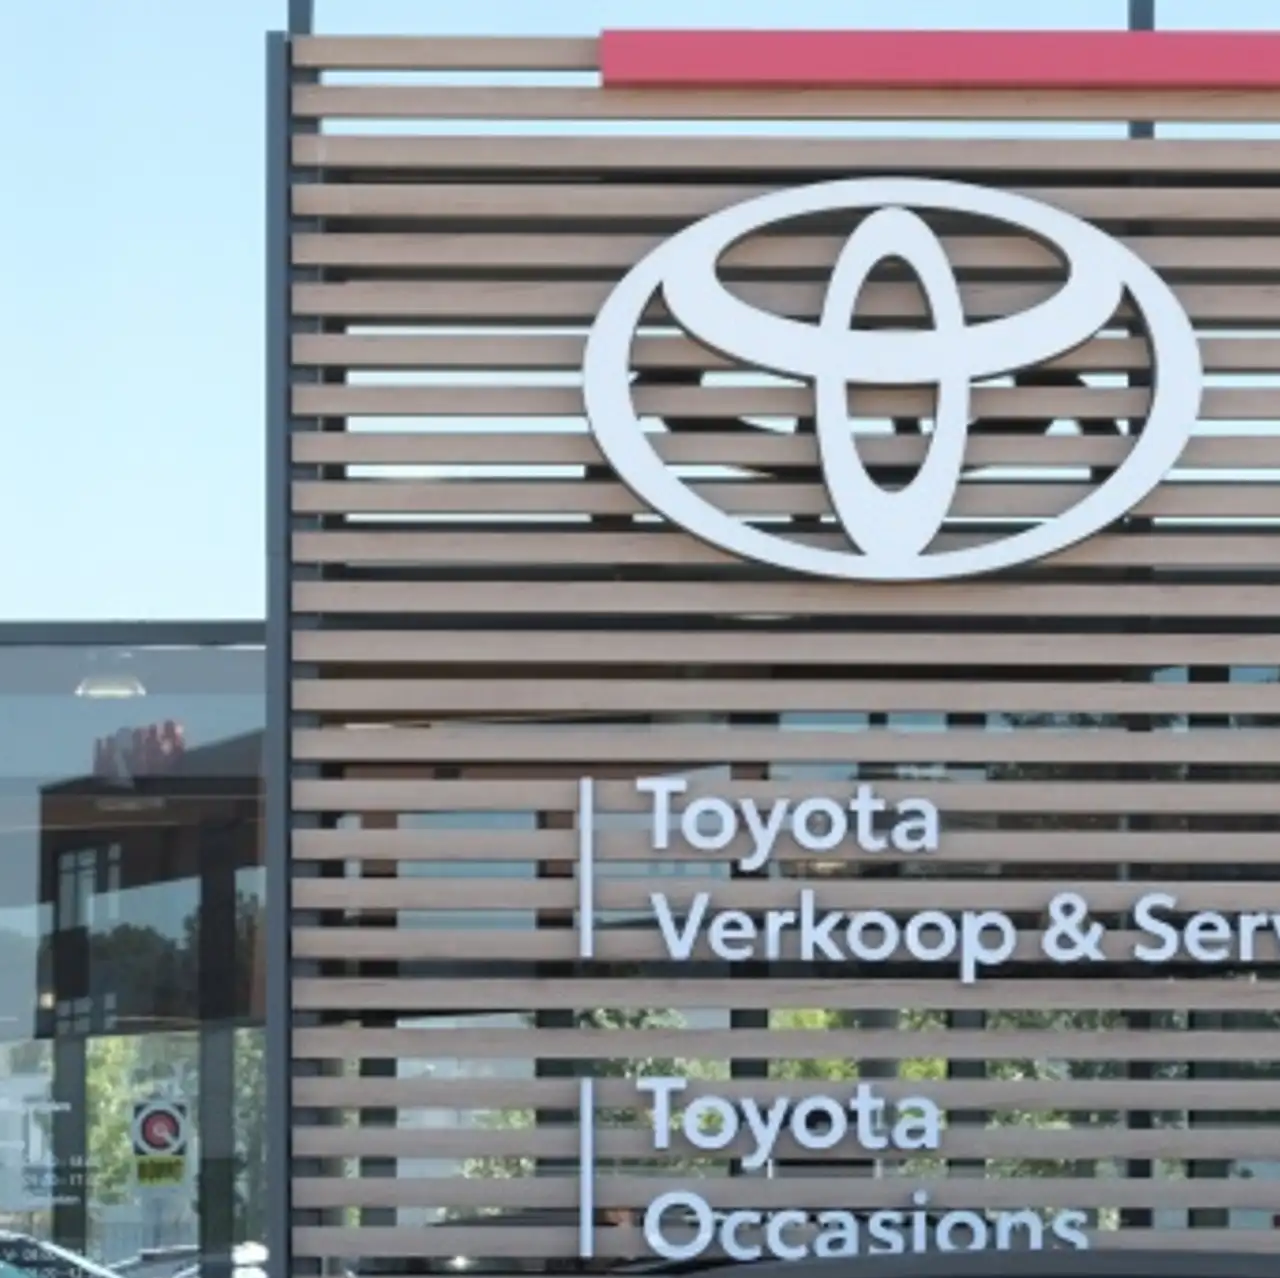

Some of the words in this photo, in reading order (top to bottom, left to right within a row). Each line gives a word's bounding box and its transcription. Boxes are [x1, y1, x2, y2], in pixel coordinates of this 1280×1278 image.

[635, 776, 940, 872] Toyota
[650, 888, 1018, 984] Verkoop
[1041, 892, 1106, 963] &
[635, 1077, 942, 1170] Toyota
[643, 1189, 1090, 1261] Occasions
